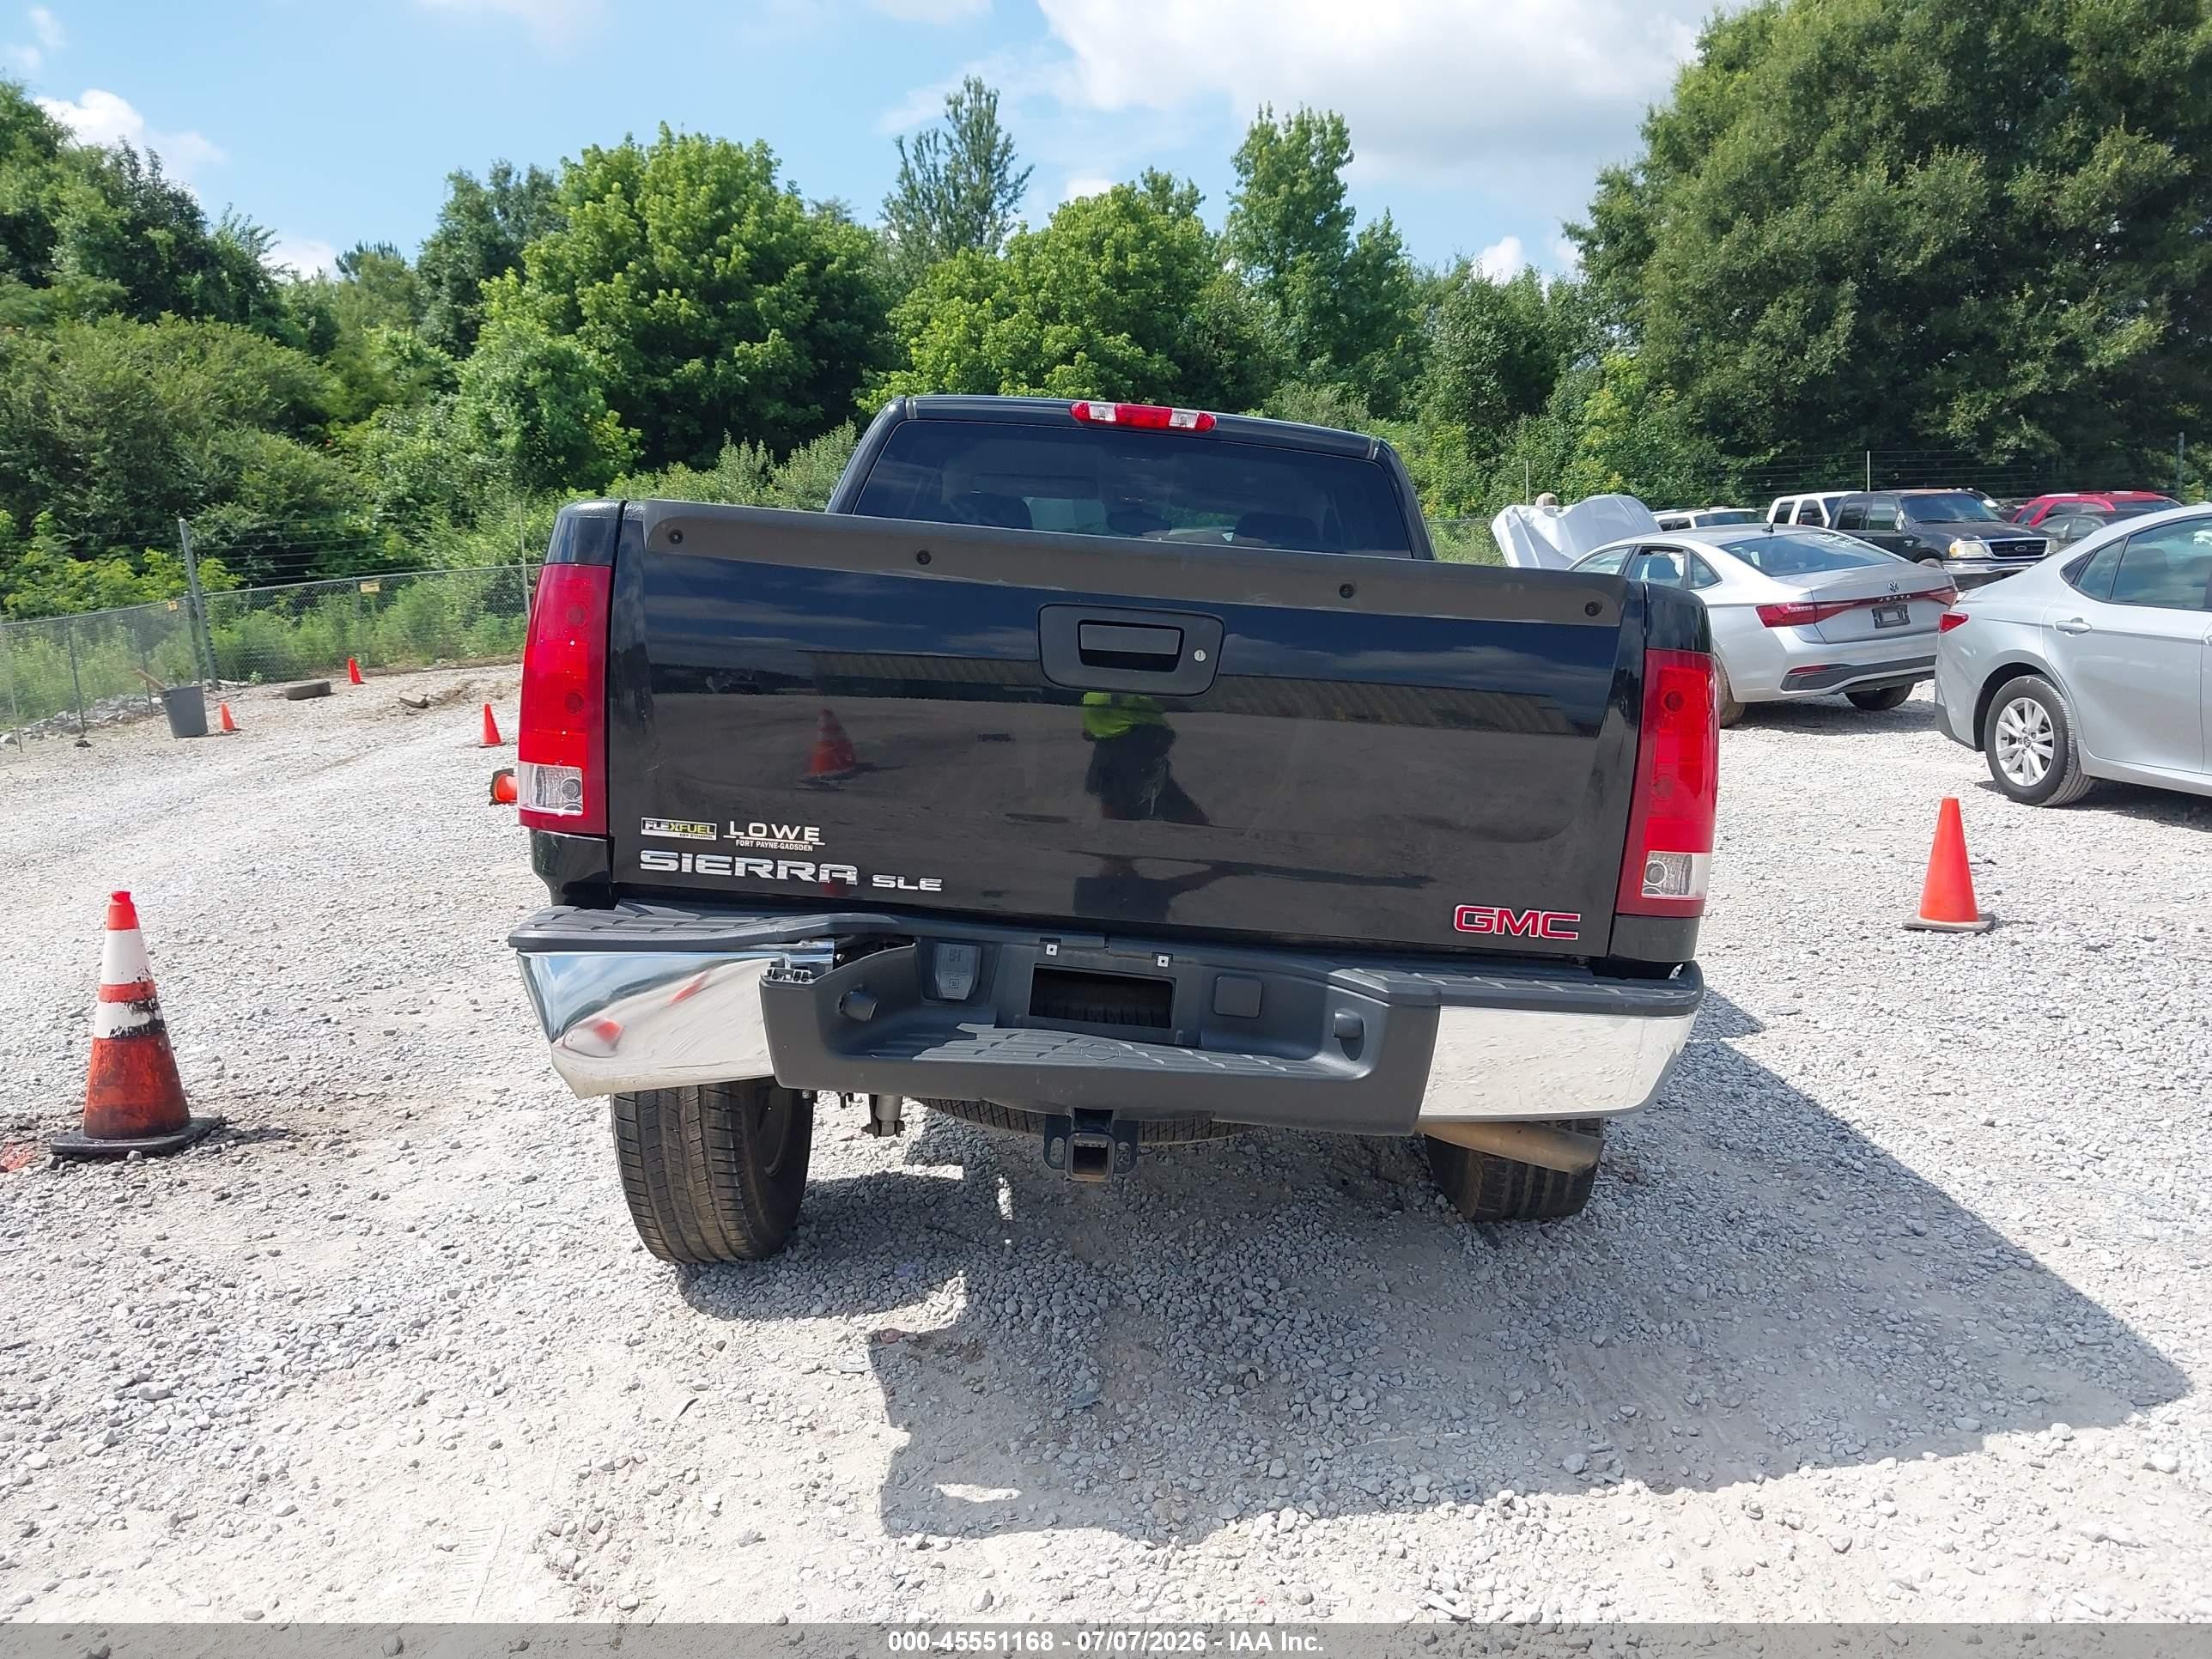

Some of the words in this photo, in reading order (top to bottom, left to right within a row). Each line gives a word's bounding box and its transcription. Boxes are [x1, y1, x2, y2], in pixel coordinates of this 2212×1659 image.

[645, 820, 714, 835] FLEXFUEL
[729, 820, 820, 842] LOWE
[735, 839, 755, 848] FORT
[756, 840, 814, 852] PAYNE-GADSDEN
[640, 849, 858, 886] SIERRA
[872, 874, 943, 892] SLE
[1454, 904, 1581, 940] GMC
